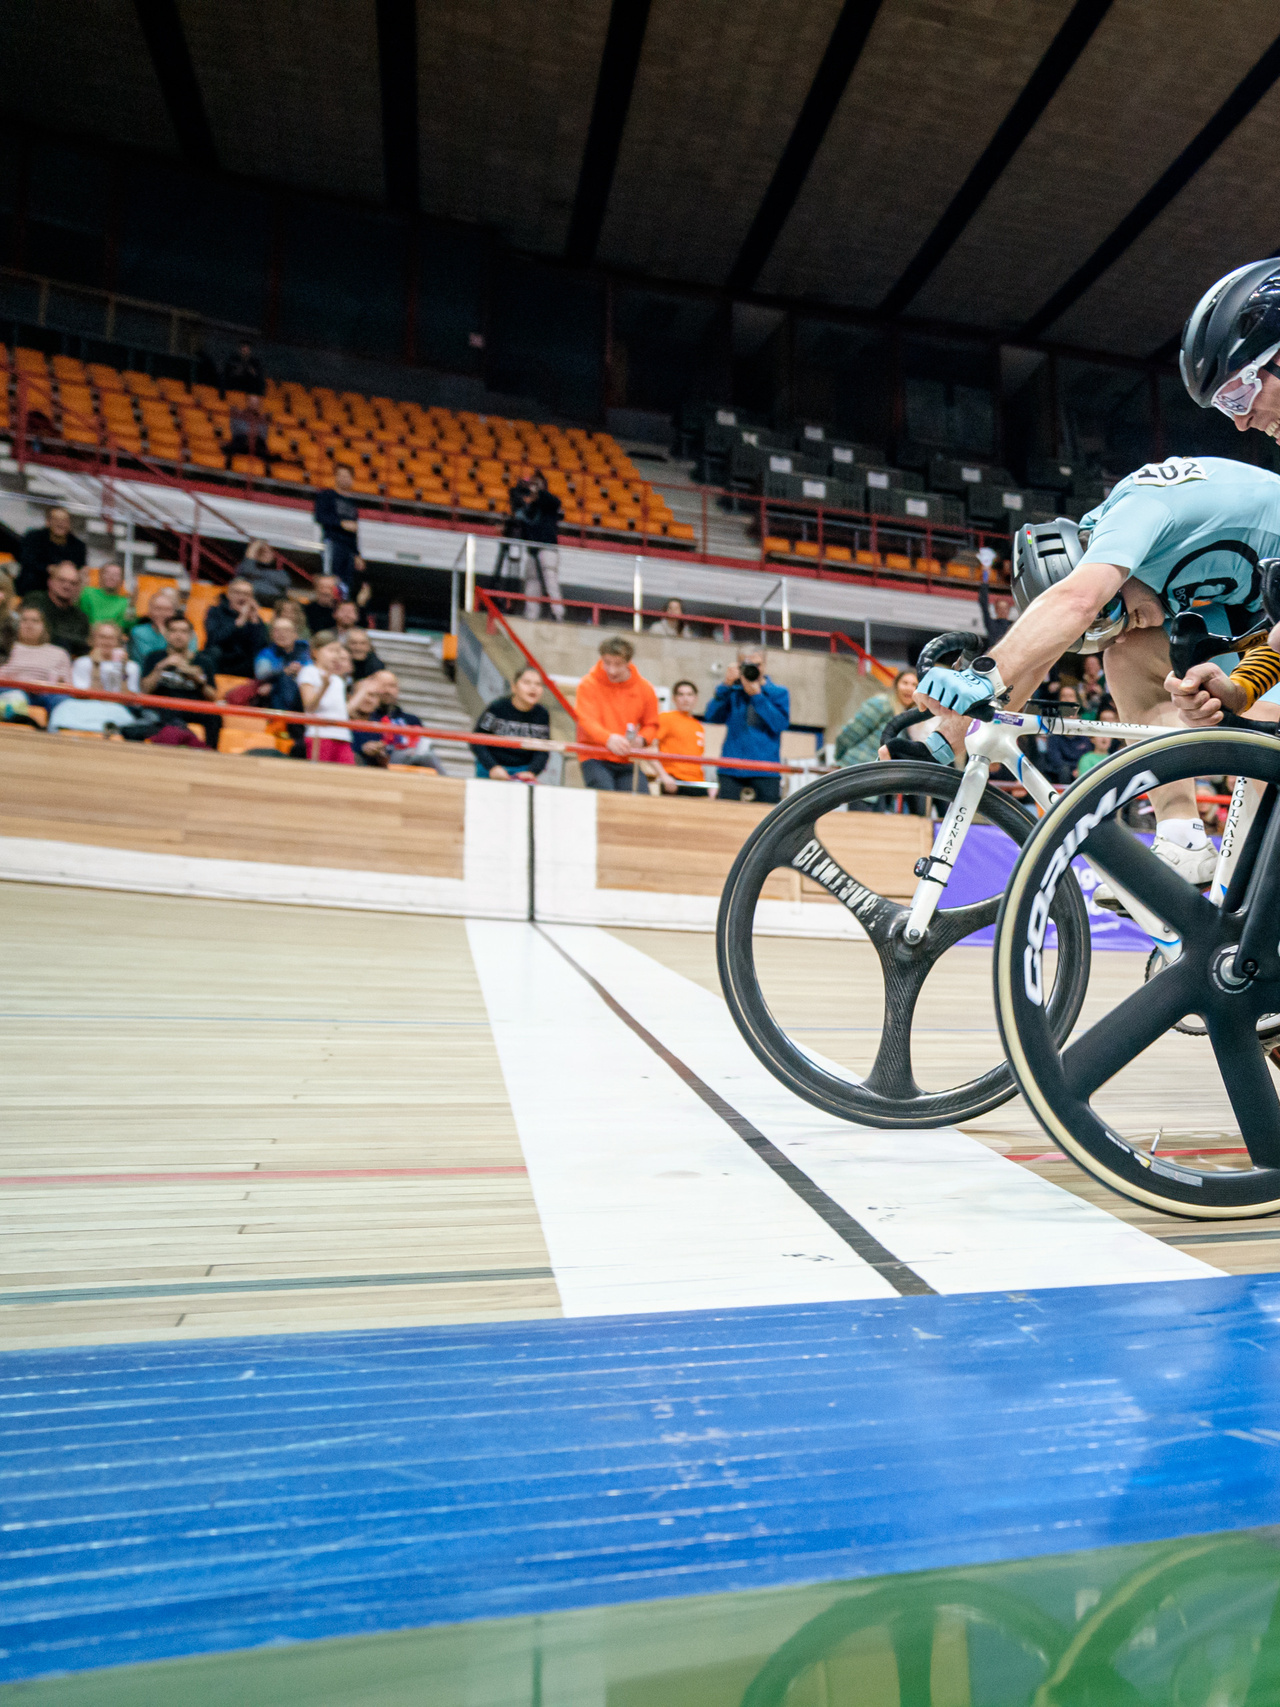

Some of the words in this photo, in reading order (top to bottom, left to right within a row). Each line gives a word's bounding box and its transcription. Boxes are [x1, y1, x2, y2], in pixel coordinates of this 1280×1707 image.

[940, 806, 967, 862] COLNAGO
[1221, 789, 1245, 858] COLNAGO
[1024, 769, 1160, 1006] CORIMA
